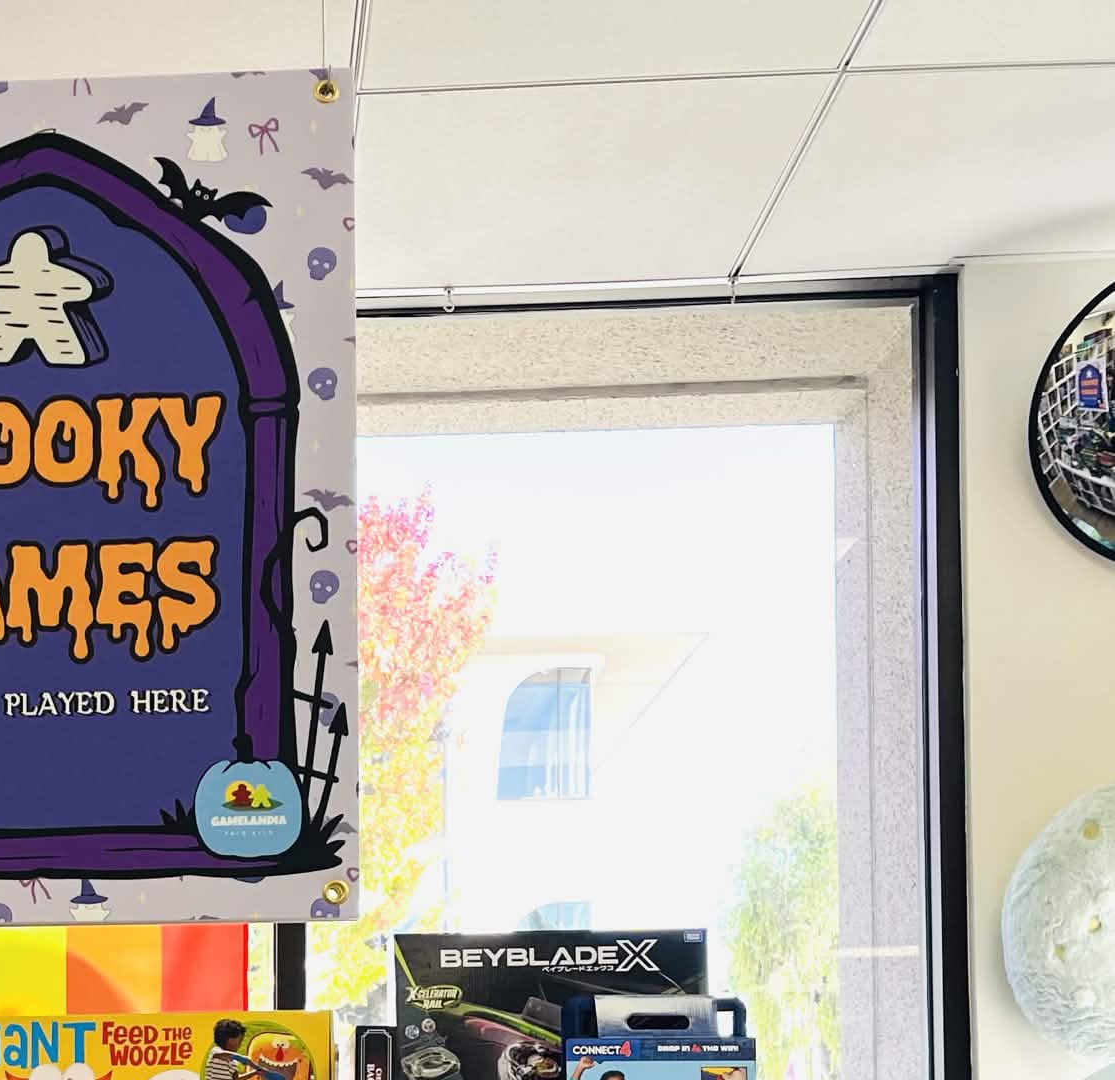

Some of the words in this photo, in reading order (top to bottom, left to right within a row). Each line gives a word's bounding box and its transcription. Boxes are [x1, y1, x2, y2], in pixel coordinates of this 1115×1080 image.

[211, 815, 287, 826] GAMELANDIA
[423, 1000, 443, 1010] RAIL
[572, 1045, 621, 1056] CONNECT
[620, 1041, 632, 1057] 4
